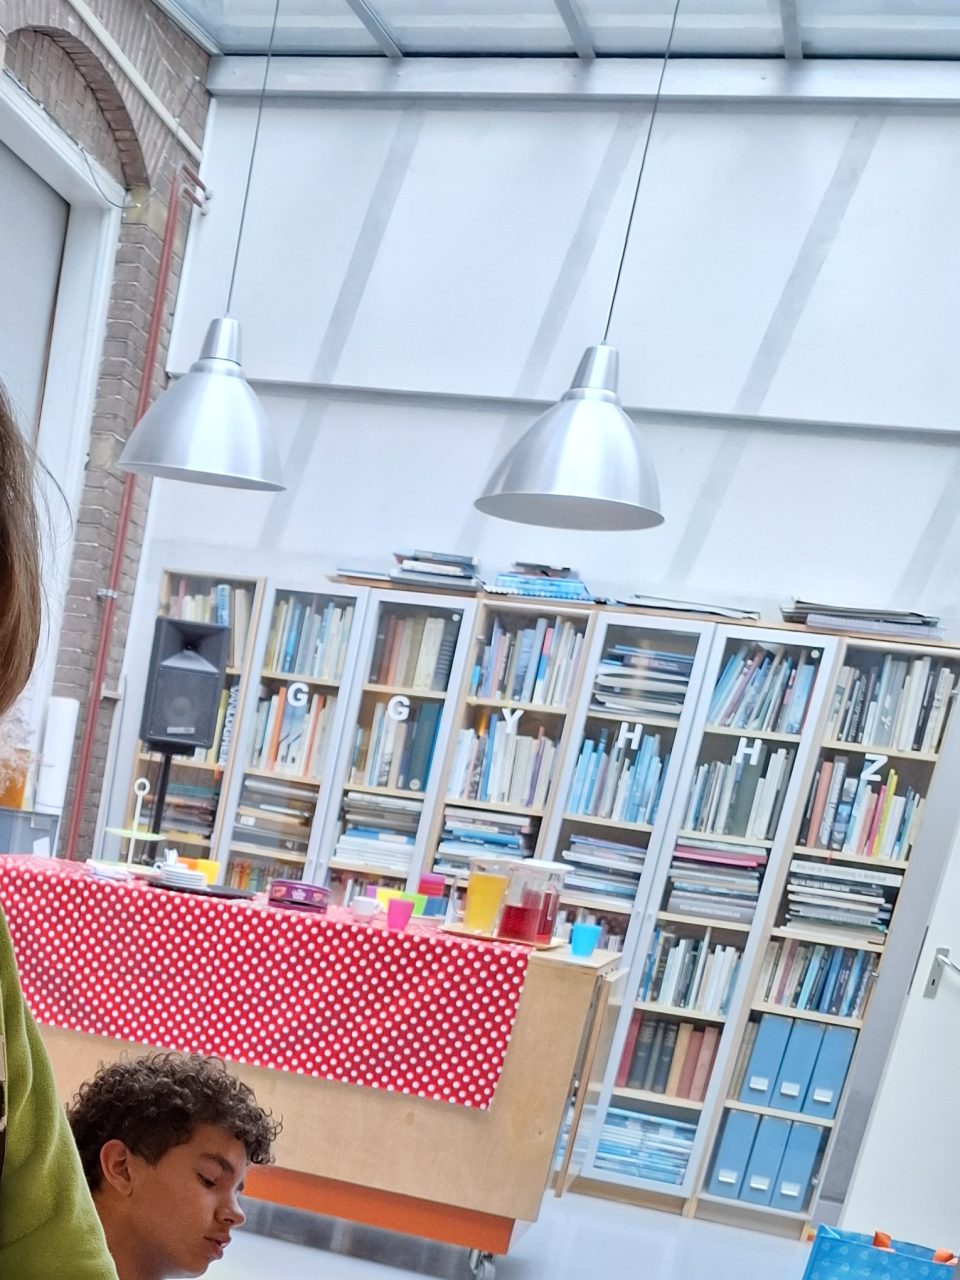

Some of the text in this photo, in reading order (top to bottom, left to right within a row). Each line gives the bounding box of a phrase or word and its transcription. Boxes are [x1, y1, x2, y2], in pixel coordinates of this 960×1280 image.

[287, 682, 309, 707] G
[388, 696, 410, 721] G
[501, 709, 524, 734] Y
[617, 721, 643, 750] H
[736, 737, 762, 765] H
[861, 753, 888, 781] Z
